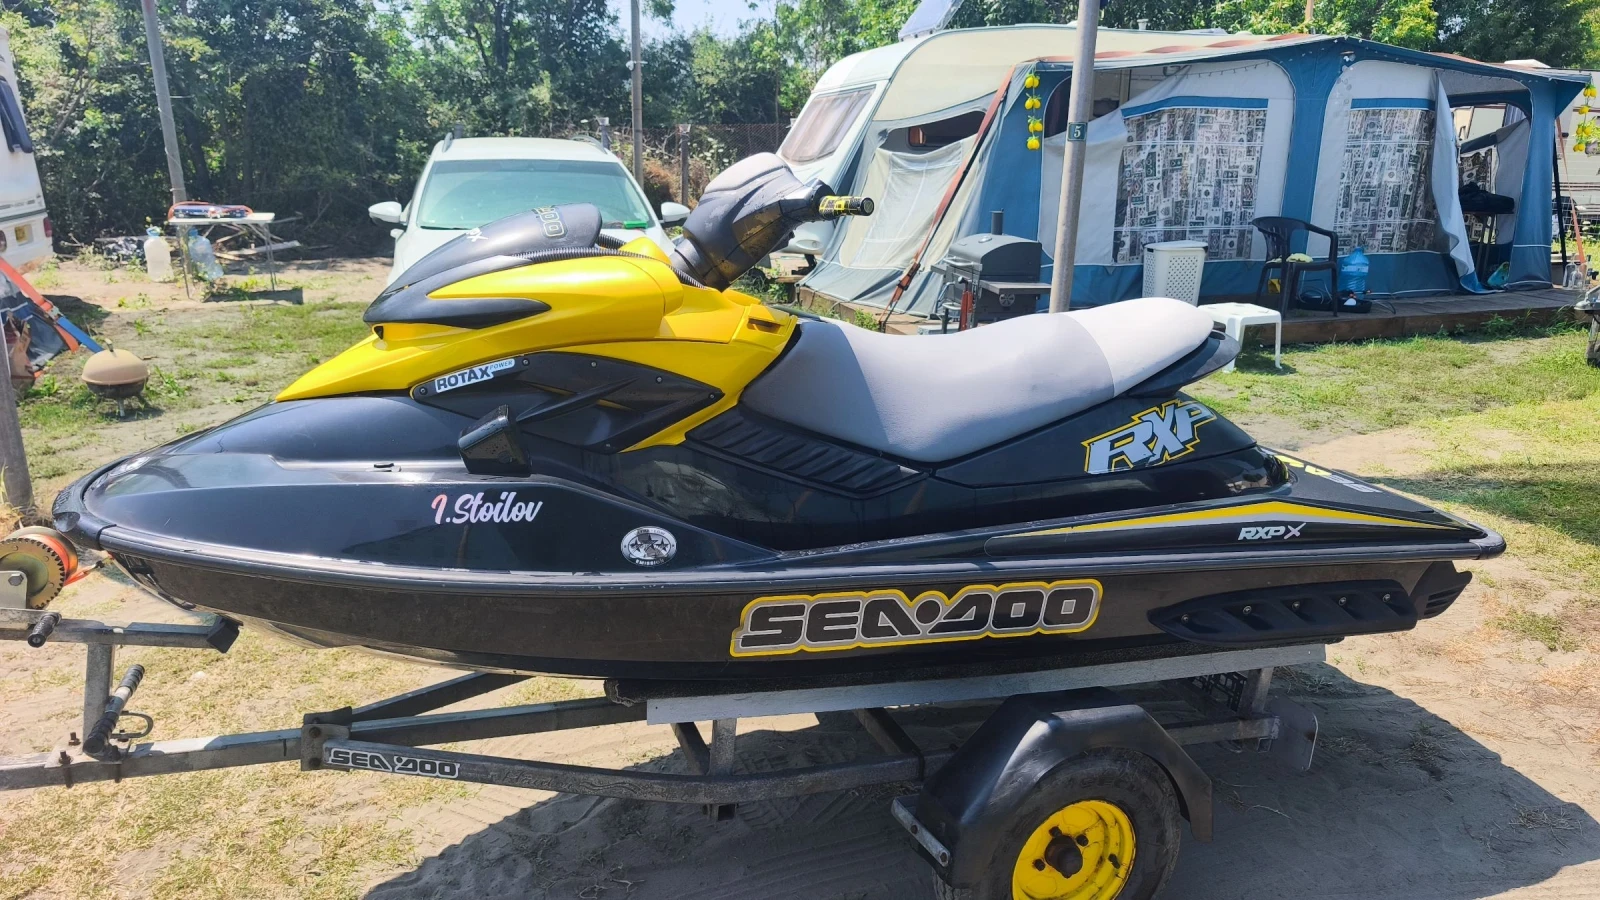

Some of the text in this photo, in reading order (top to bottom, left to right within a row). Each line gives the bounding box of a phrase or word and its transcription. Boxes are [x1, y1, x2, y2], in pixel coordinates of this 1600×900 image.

[1073, 125, 1082, 138] 5
[436, 360, 514, 390] ROTAX POWER
[1086, 402, 1216, 474] RXP
